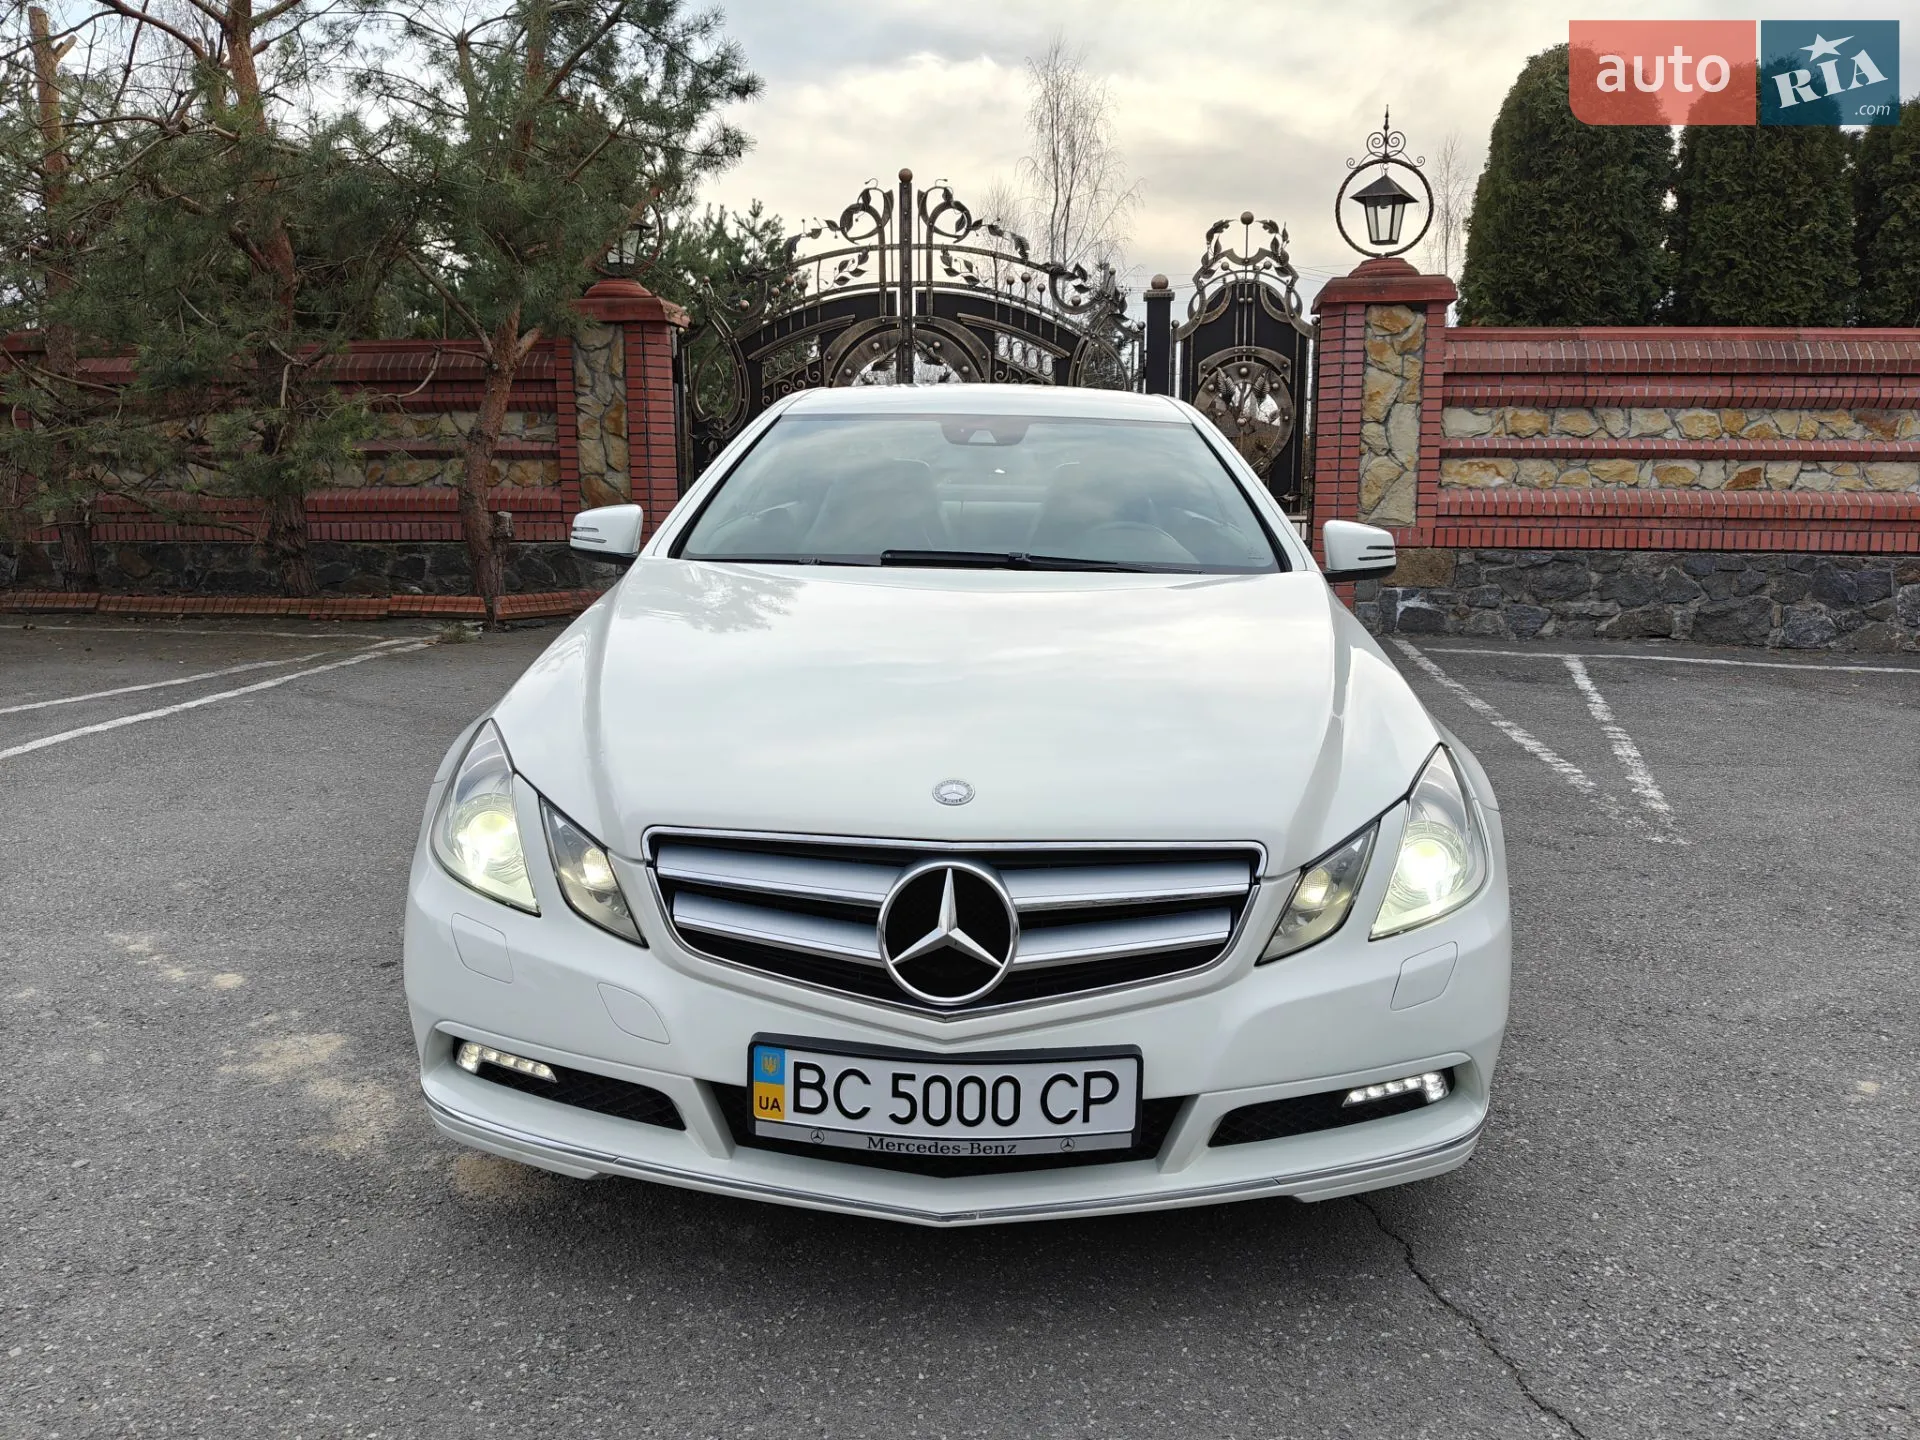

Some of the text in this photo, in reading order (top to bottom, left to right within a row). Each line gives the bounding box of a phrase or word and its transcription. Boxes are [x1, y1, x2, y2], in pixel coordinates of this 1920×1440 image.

[793, 1060, 1120, 1128] BC 5000 CP
[758, 1095, 782, 1113] UA
[867, 1137, 1017, 1155] Mercedes-Benz
